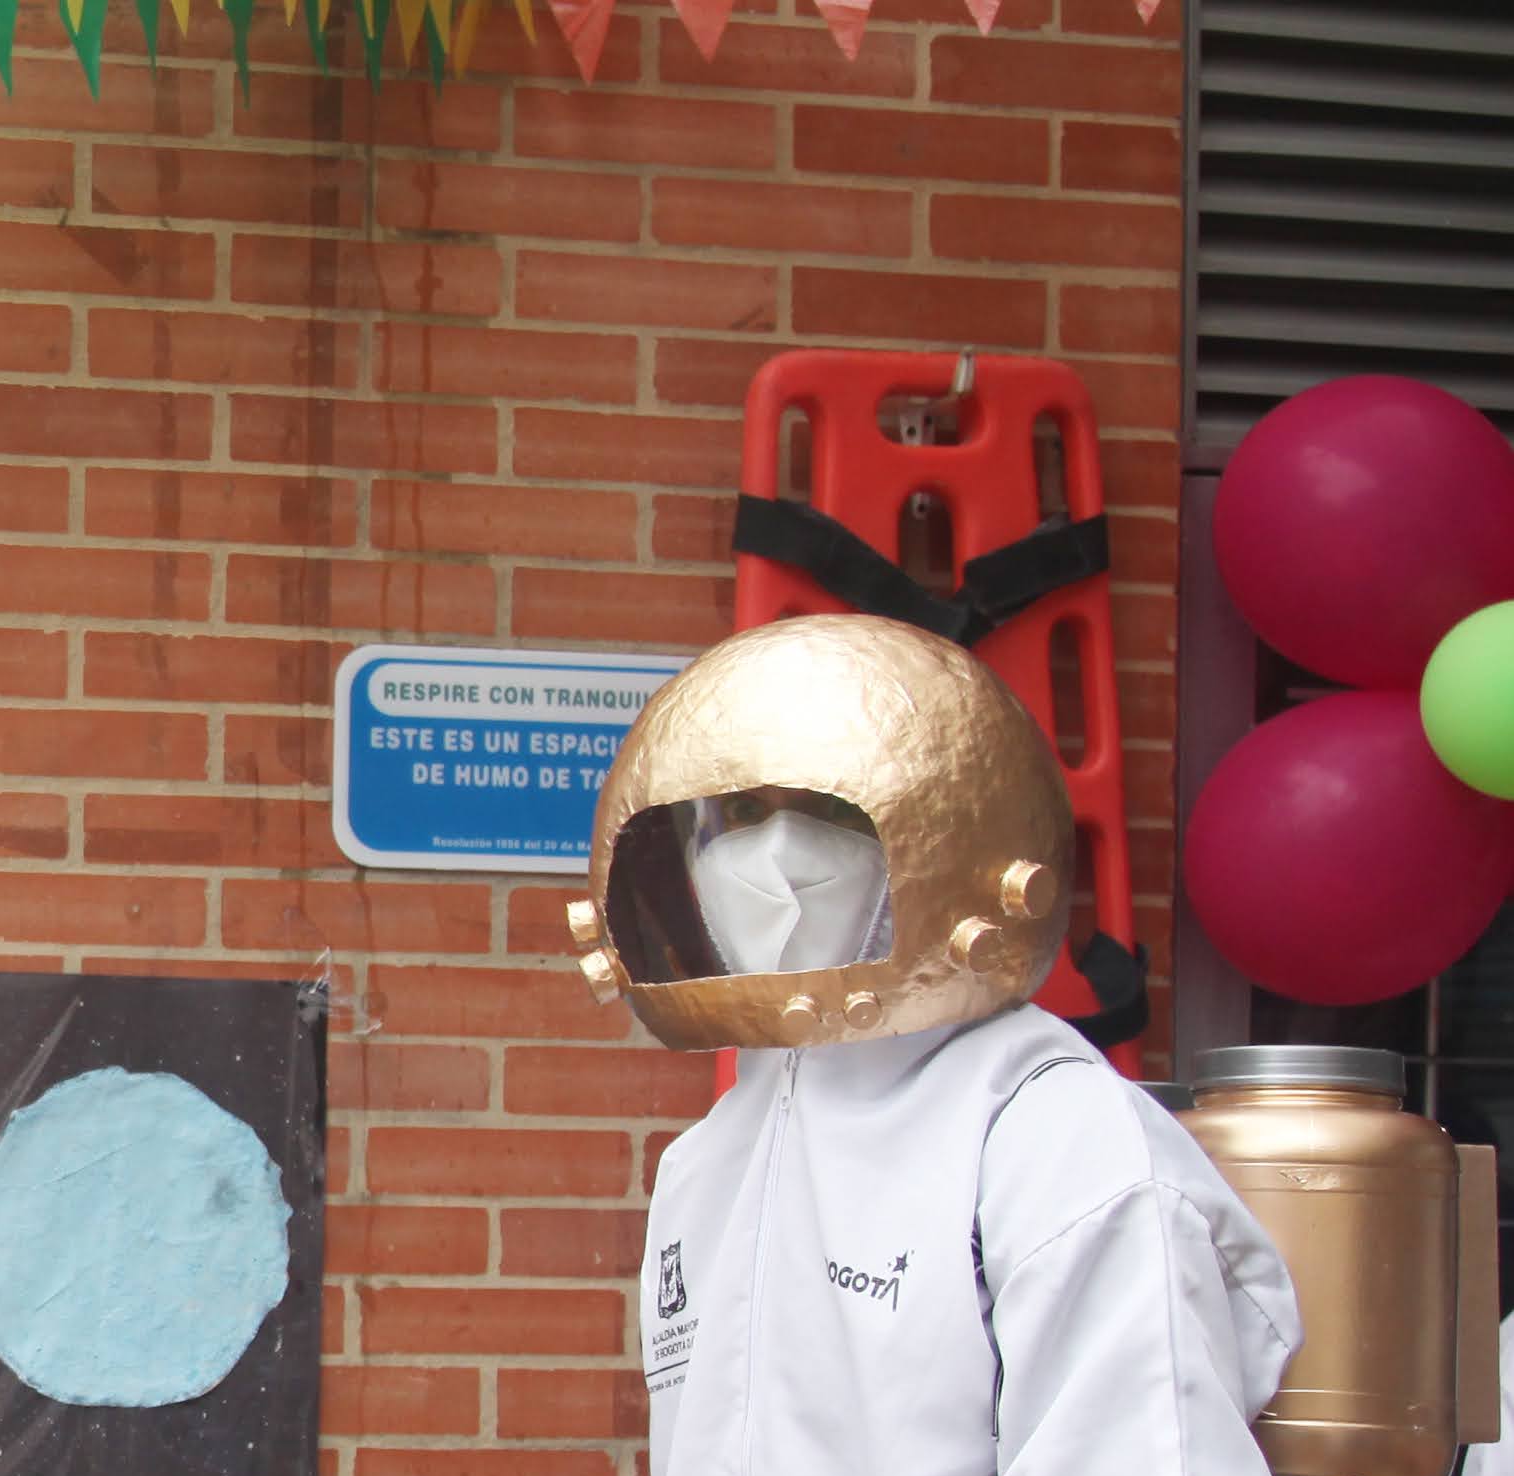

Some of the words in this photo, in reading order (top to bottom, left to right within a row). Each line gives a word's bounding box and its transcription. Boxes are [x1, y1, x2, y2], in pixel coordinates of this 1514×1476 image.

[383, 681, 480, 704] RESPIRE
[489, 686, 535, 706] CON
[370, 727, 434, 752] ESTE
[444, 729, 474, 753] ES
[484, 731, 519, 754] UN
[529, 733, 625, 758] ESPACI
[412, 763, 445, 786] DE
[454, 764, 530, 789] HUMO
[539, 767, 572, 790] DE
